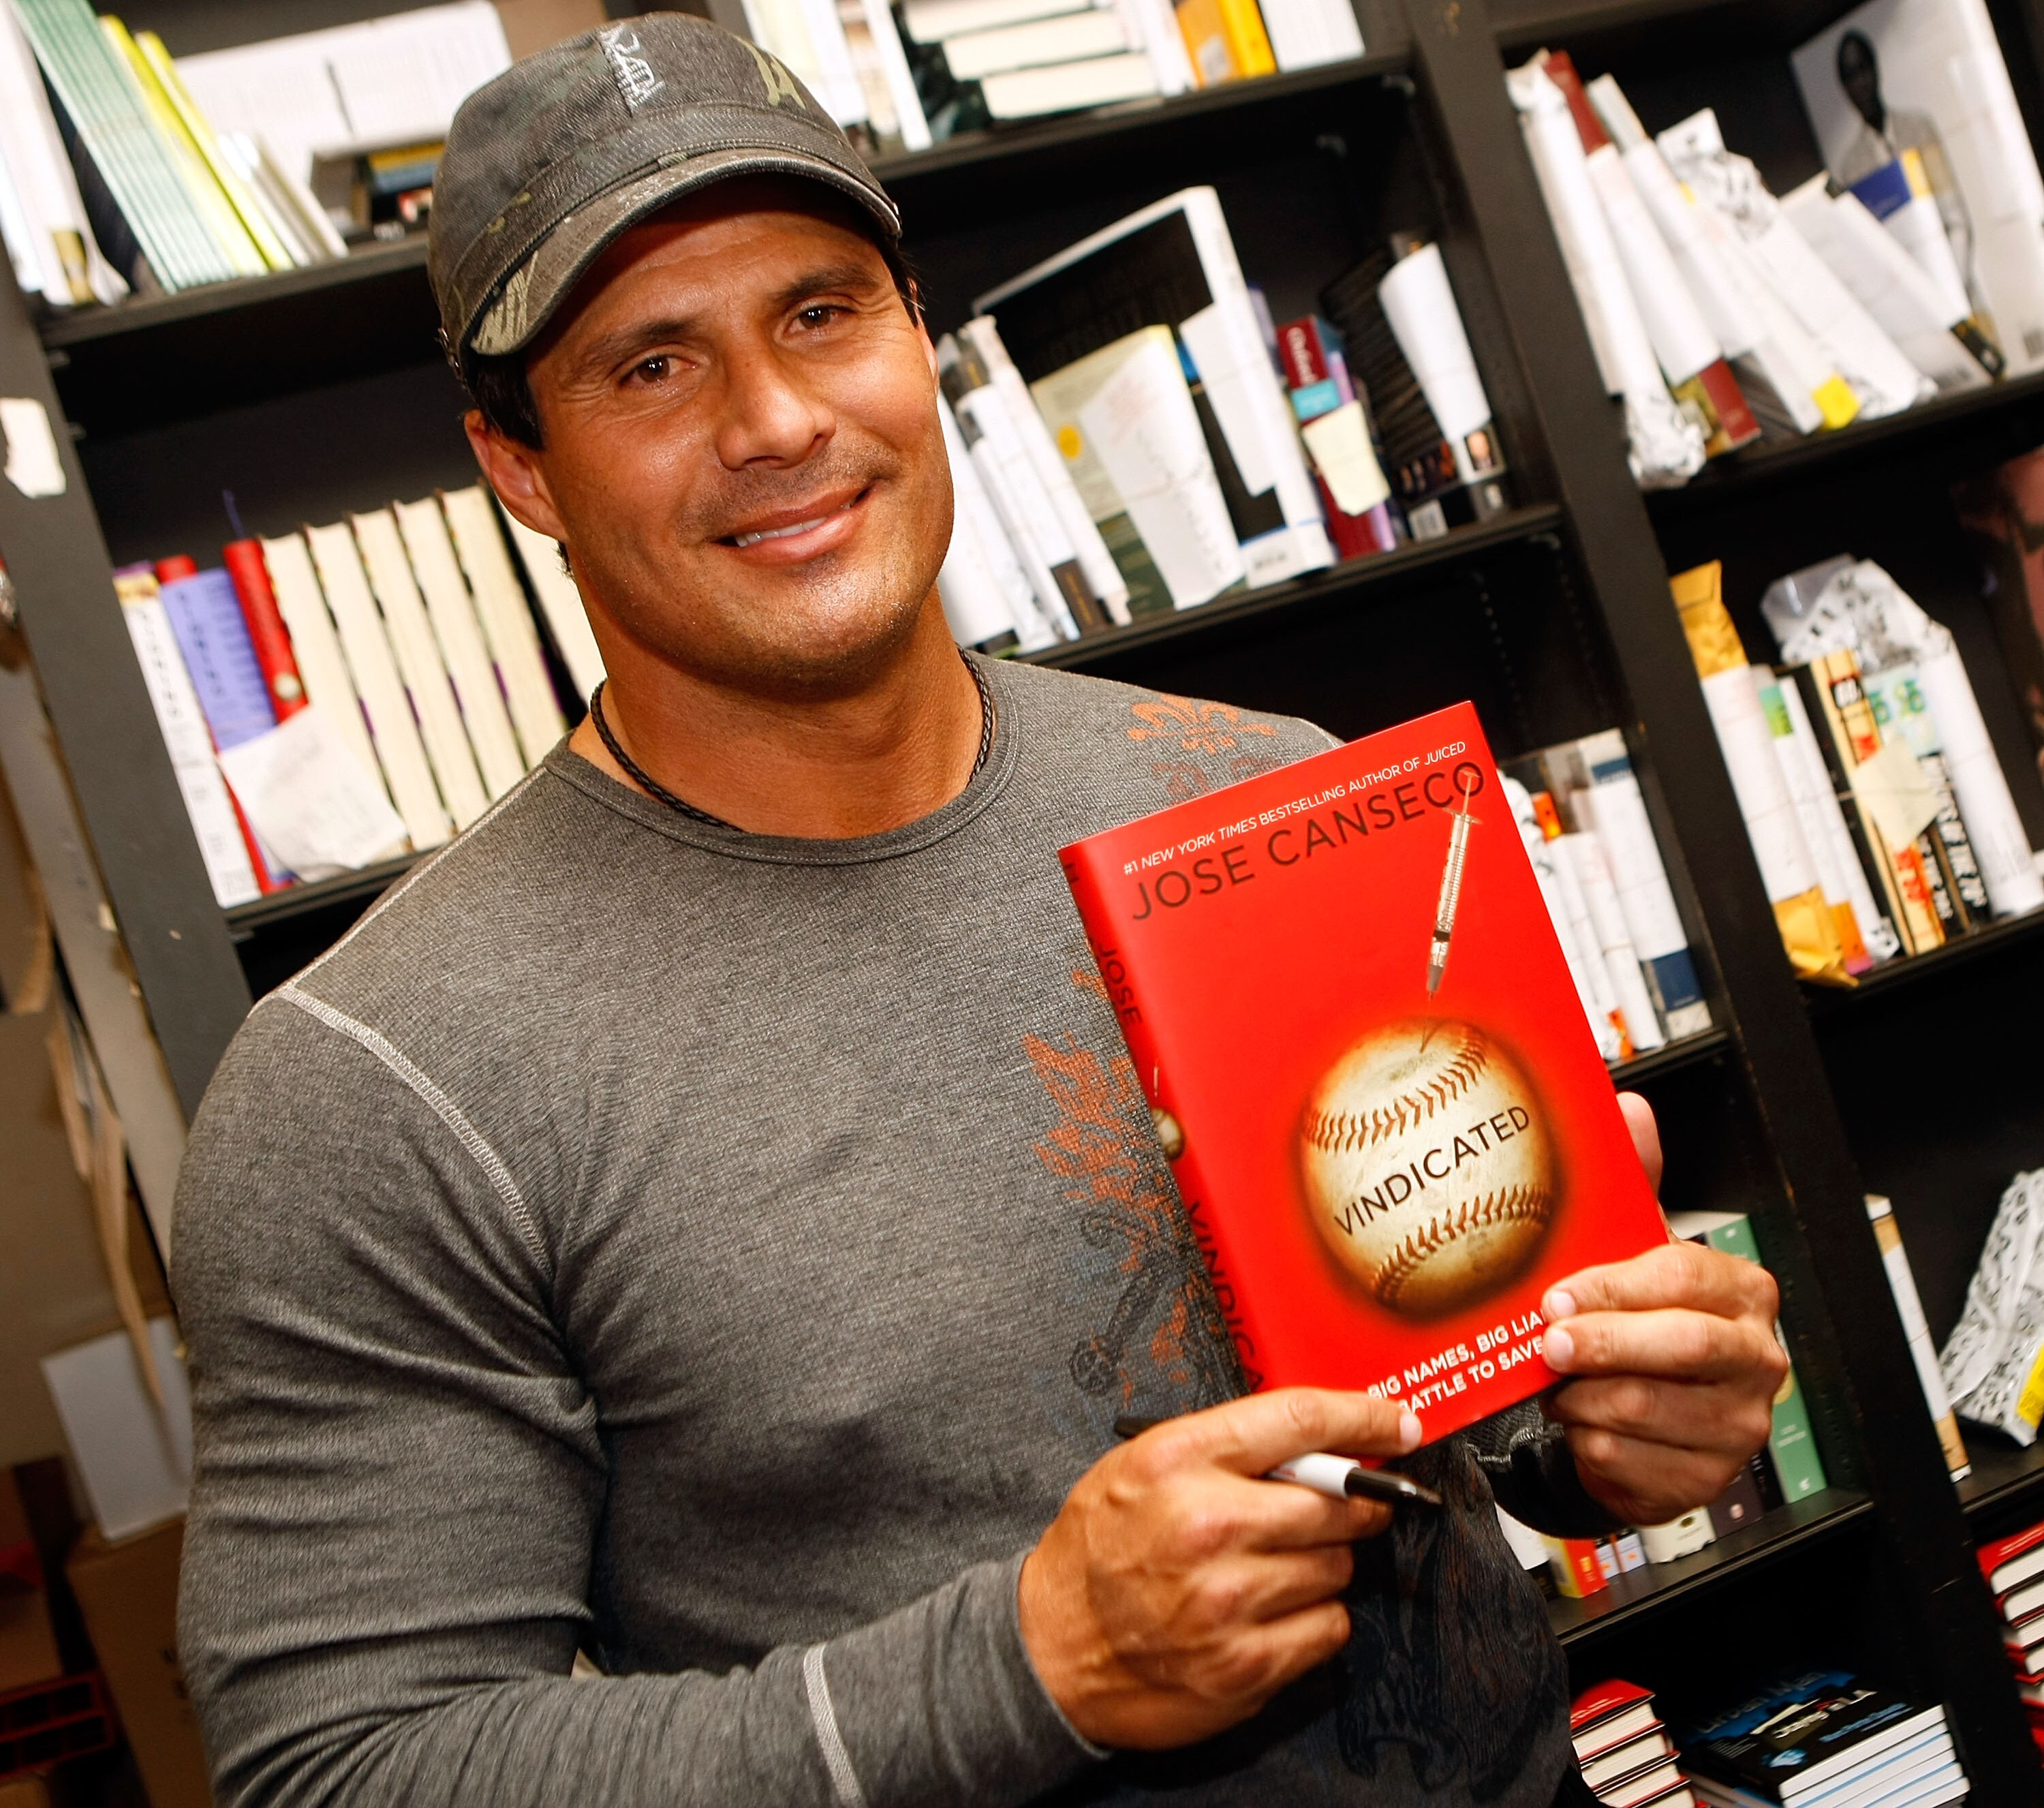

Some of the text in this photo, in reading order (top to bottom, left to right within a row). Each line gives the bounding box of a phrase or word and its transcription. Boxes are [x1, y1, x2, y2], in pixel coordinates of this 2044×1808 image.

[1124, 741, 1466, 875] #1 NEW YORK TIMES BESTSELLING AUTHOR OF JUICED
[1132, 761, 1484, 920] JOSE CANSECO
[1099, 943, 1143, 1023] JOSE
[1334, 1106, 1530, 1236] VINDICATED
[1367, 1308, 1546, 1399] BIG NAMES, BIG LIA
[1468, 1360, 1496, 1383] TO
[1498, 1335, 1543, 1371] SAVE
